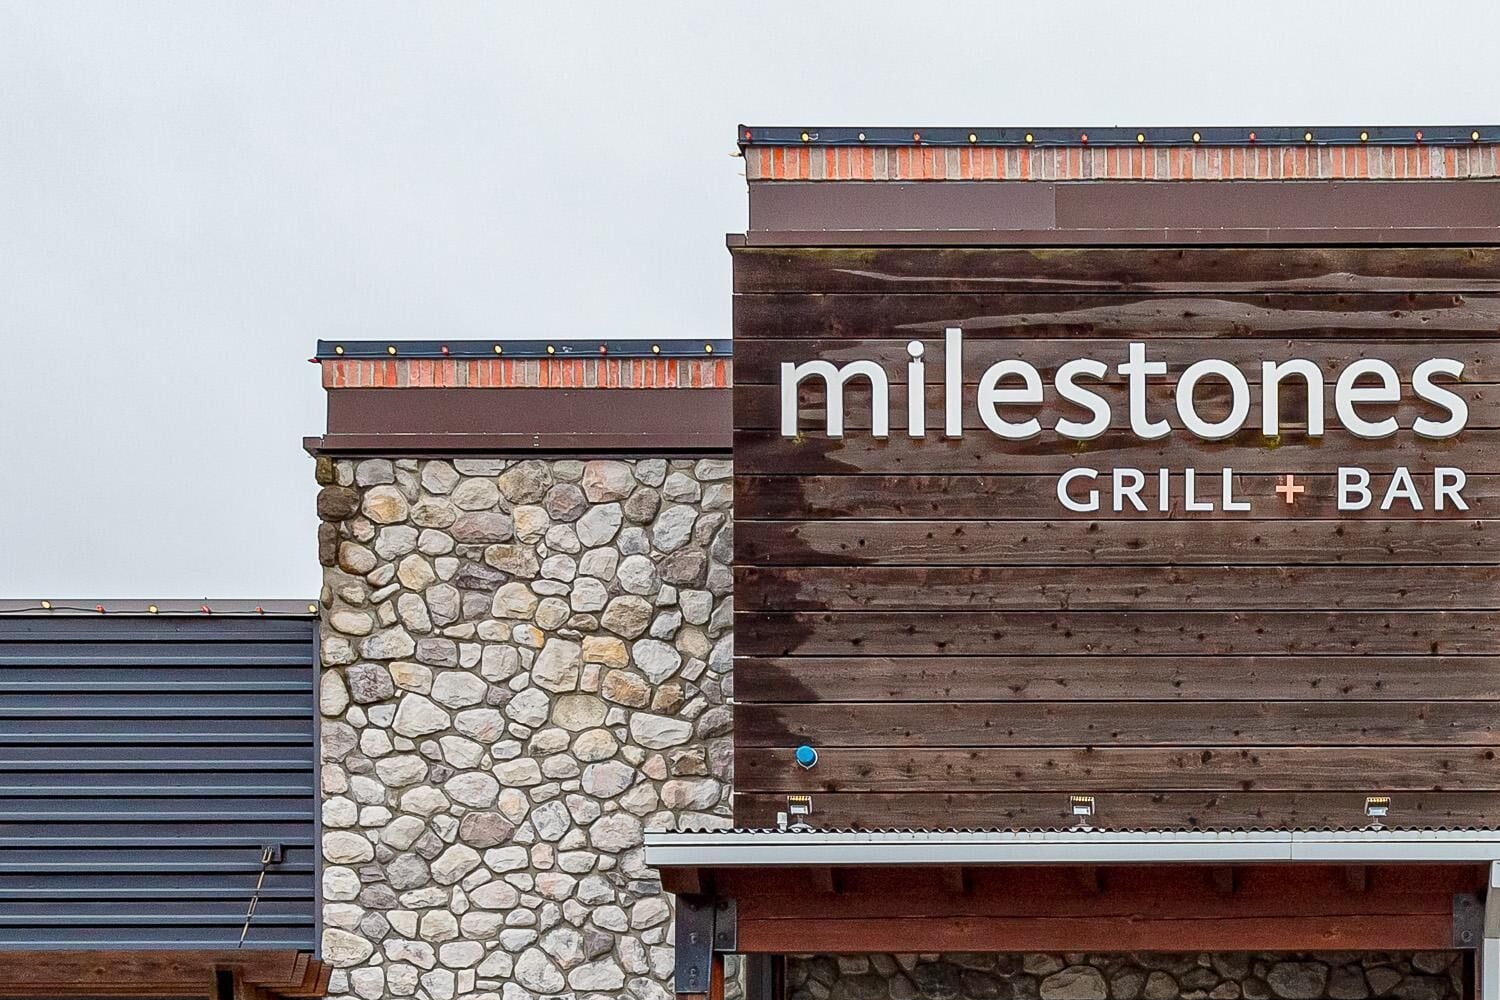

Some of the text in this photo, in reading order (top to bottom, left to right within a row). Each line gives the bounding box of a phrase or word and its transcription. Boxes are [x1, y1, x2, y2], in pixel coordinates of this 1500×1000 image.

[780, 327, 1470, 441] milestones
[1057, 466, 1251, 514] GRILL
[1337, 466, 1470, 512] BAR
